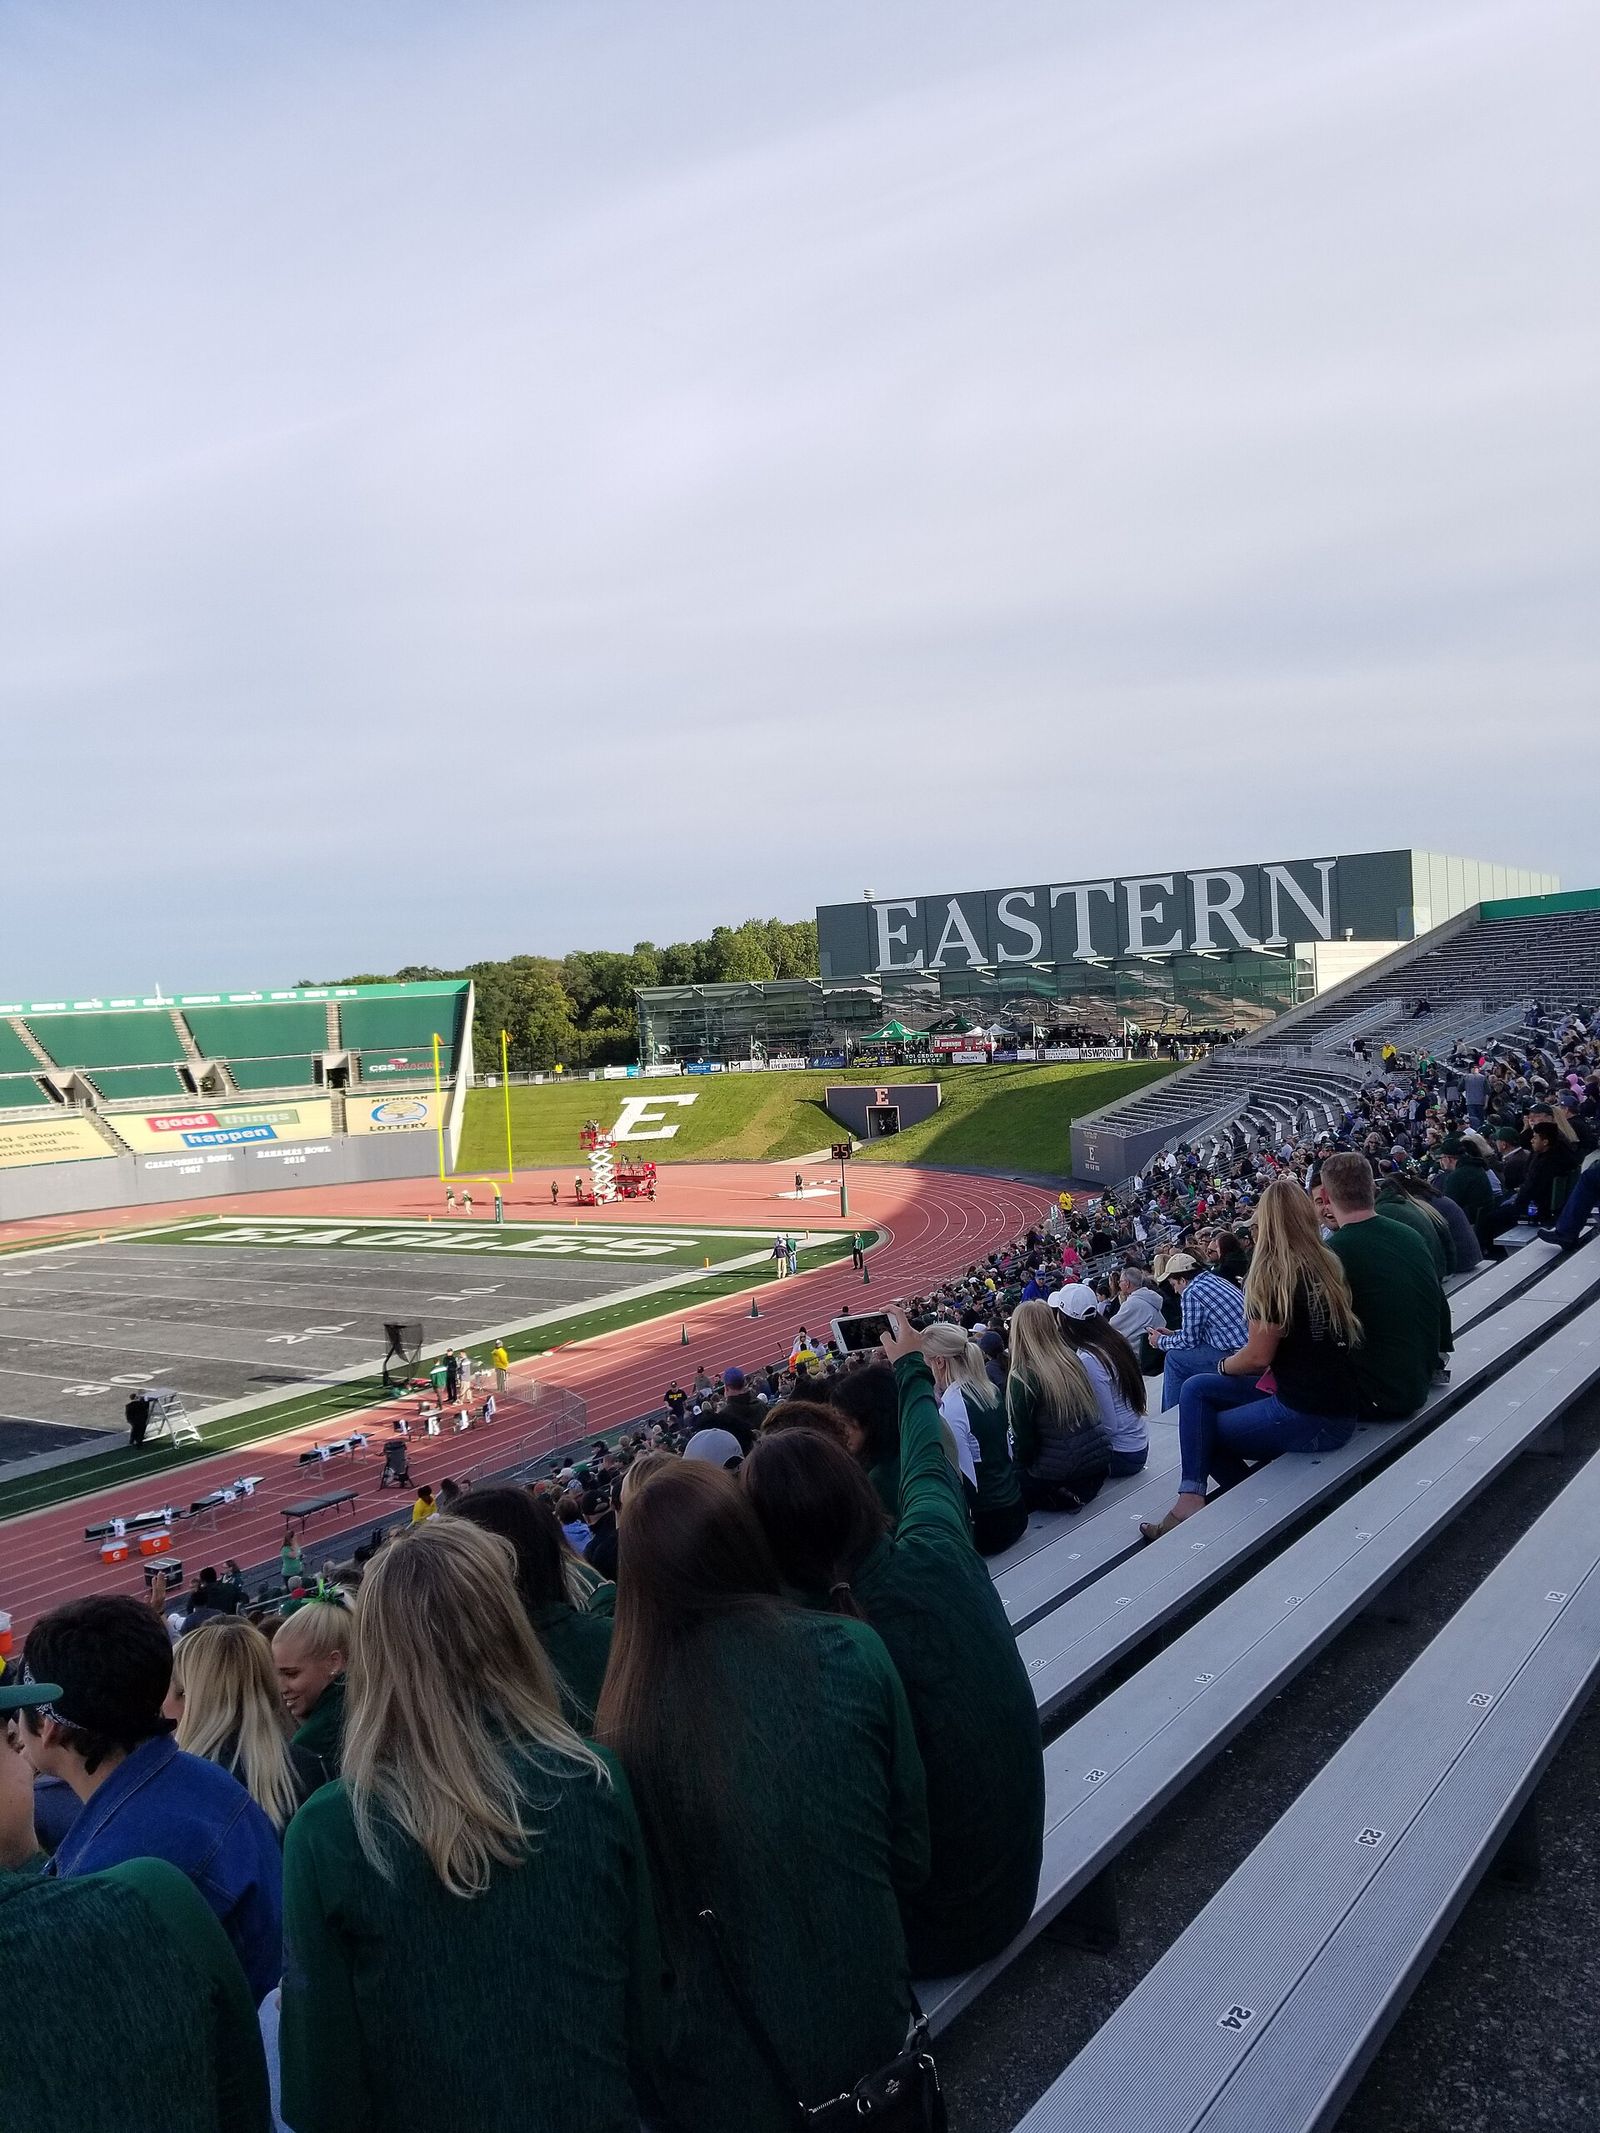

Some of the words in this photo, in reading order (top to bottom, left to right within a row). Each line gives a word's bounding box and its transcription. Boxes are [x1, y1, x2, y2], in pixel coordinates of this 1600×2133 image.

[872, 860, 1337, 972] EASTERN
[1081, 1048, 1121, 1058] MSWPRINT
[371, 1095, 428, 1104] MICHIGAN
[875, 1088, 888, 1105] E
[155, 1115, 209, 1129] good
[224, 1111, 291, 1125] things
[370, 1122, 427, 1132] LOTTERY
[29, 1139, 57, 1147] and
[187, 1127, 269, 1145] happen
[304, 1145, 332, 1155] BOWL
[833, 1144, 848, 1159] 25
[207, 1154, 235, 1163] BOWL
[183, 1227, 700, 1256] EAGLES
[265, 1325, 345, 1345] 20
[61, 1373, 155, 1397] 30
[1549, 1592, 1565, 1602] 21
[1196, 1673, 1212, 1683] 21
[1469, 1693, 1490, 1706] 22
[1085, 1770, 1105, 1782] 22
[1358, 1828, 1382, 1846] 23
[1220, 2005, 1252, 2030] 24
